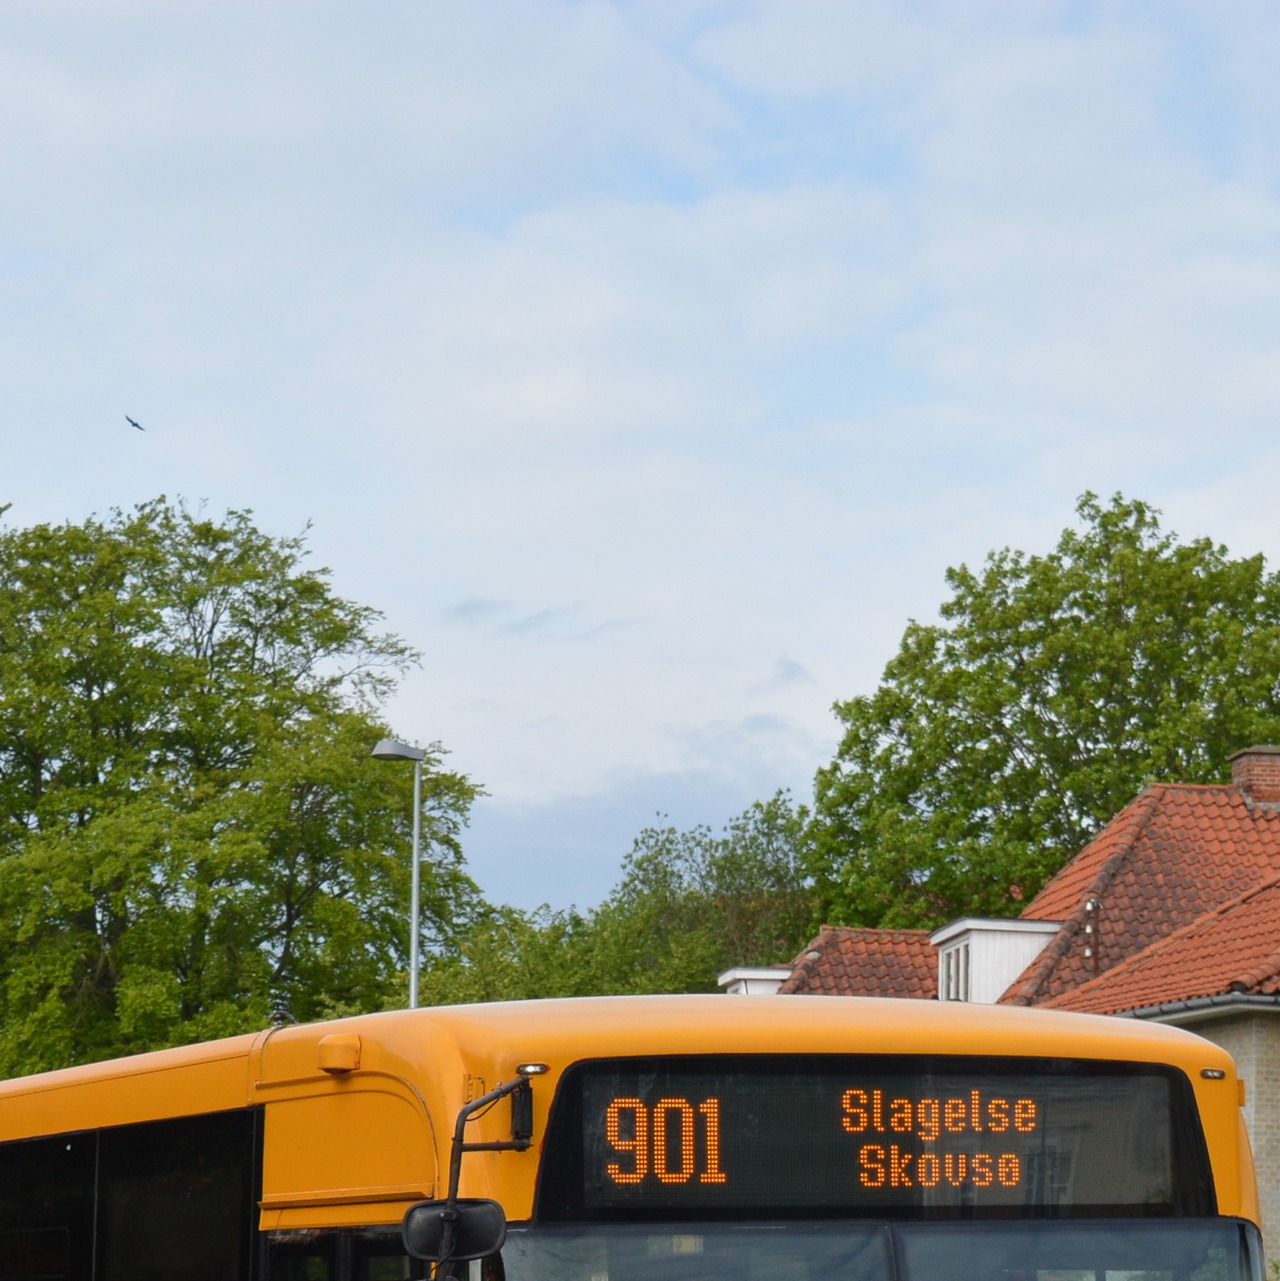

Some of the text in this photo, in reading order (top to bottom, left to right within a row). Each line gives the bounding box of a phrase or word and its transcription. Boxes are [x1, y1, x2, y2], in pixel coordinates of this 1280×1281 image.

[606, 1098, 726, 1184] 901
[841, 1090, 1037, 1141] Slagelse
[859, 1145, 1020, 1188] Skovsø
